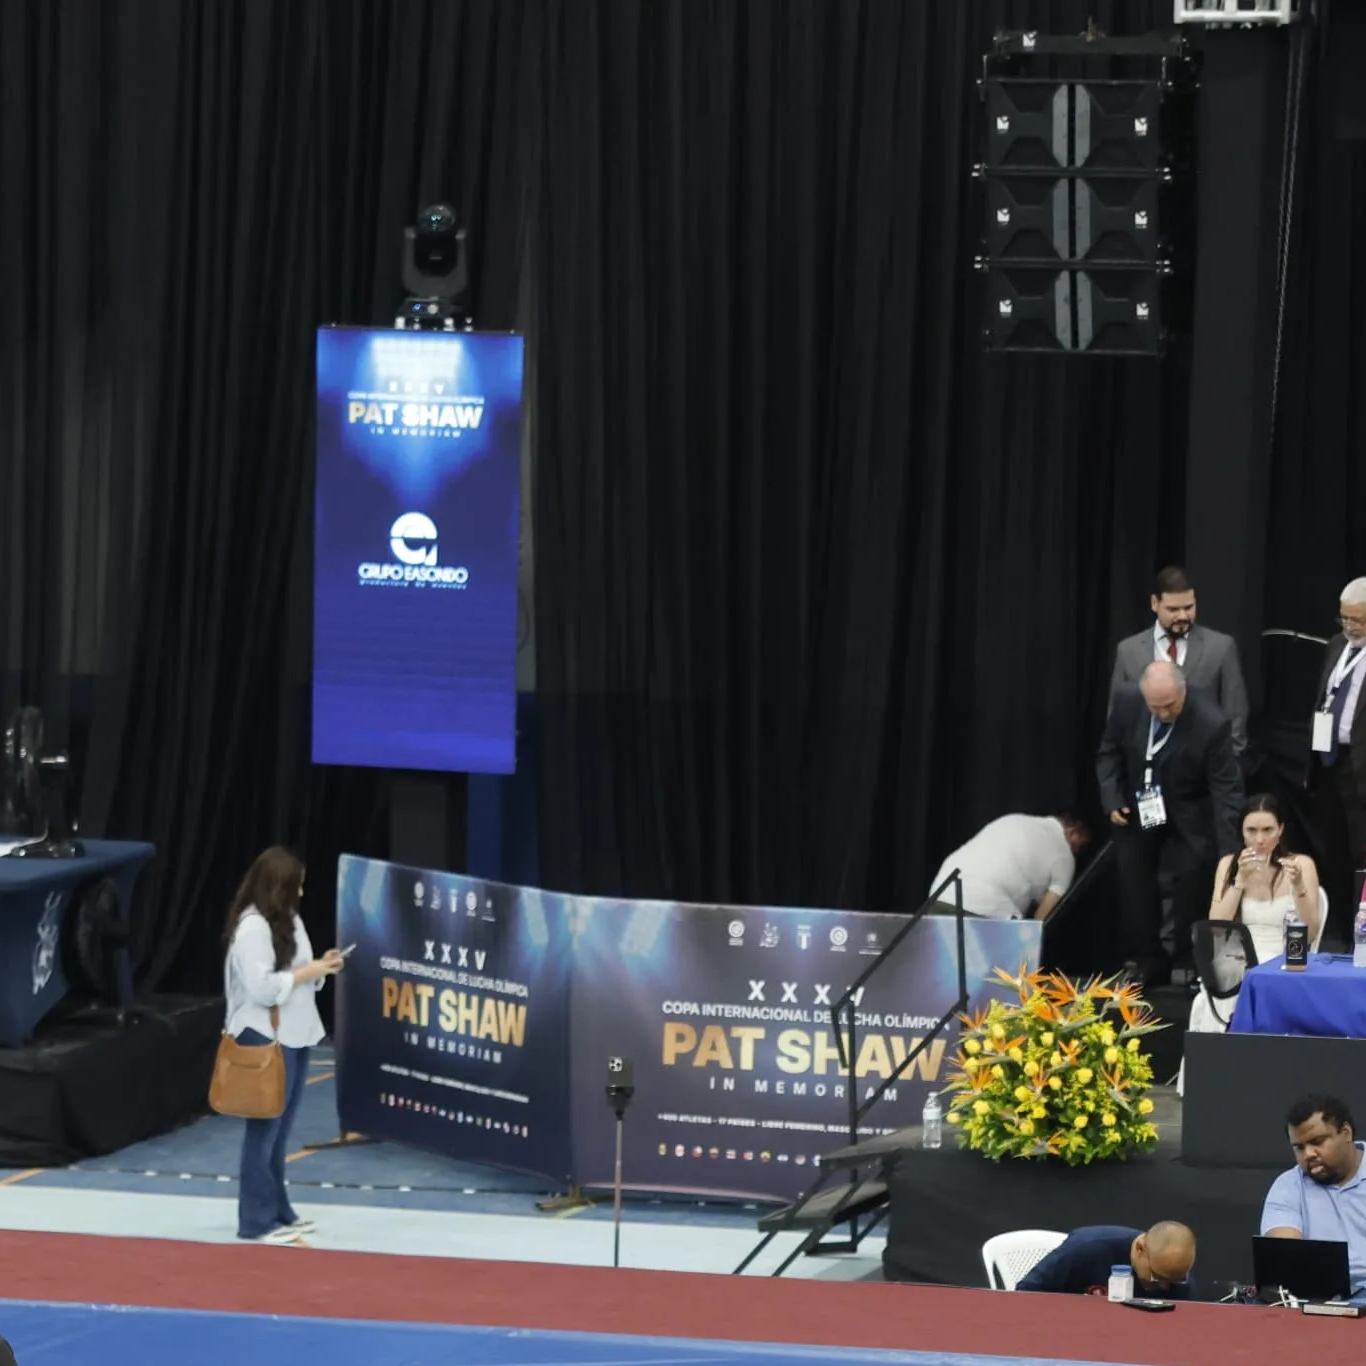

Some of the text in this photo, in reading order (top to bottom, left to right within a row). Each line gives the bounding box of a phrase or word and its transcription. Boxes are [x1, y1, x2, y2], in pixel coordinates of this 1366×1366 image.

[349, 401, 483, 429] PAT SHAW
[382, 976, 527, 1046] PAT SHAW
[662, 1001, 950, 1031] COPA INTERNACIONAL DE UCHA OLÍMPIC
[404, 1032, 502, 1064] IN MEMORIAM
[662, 1021, 946, 1082] PAT SHAW
[710, 1077, 897, 1101] IN MEMORAM
